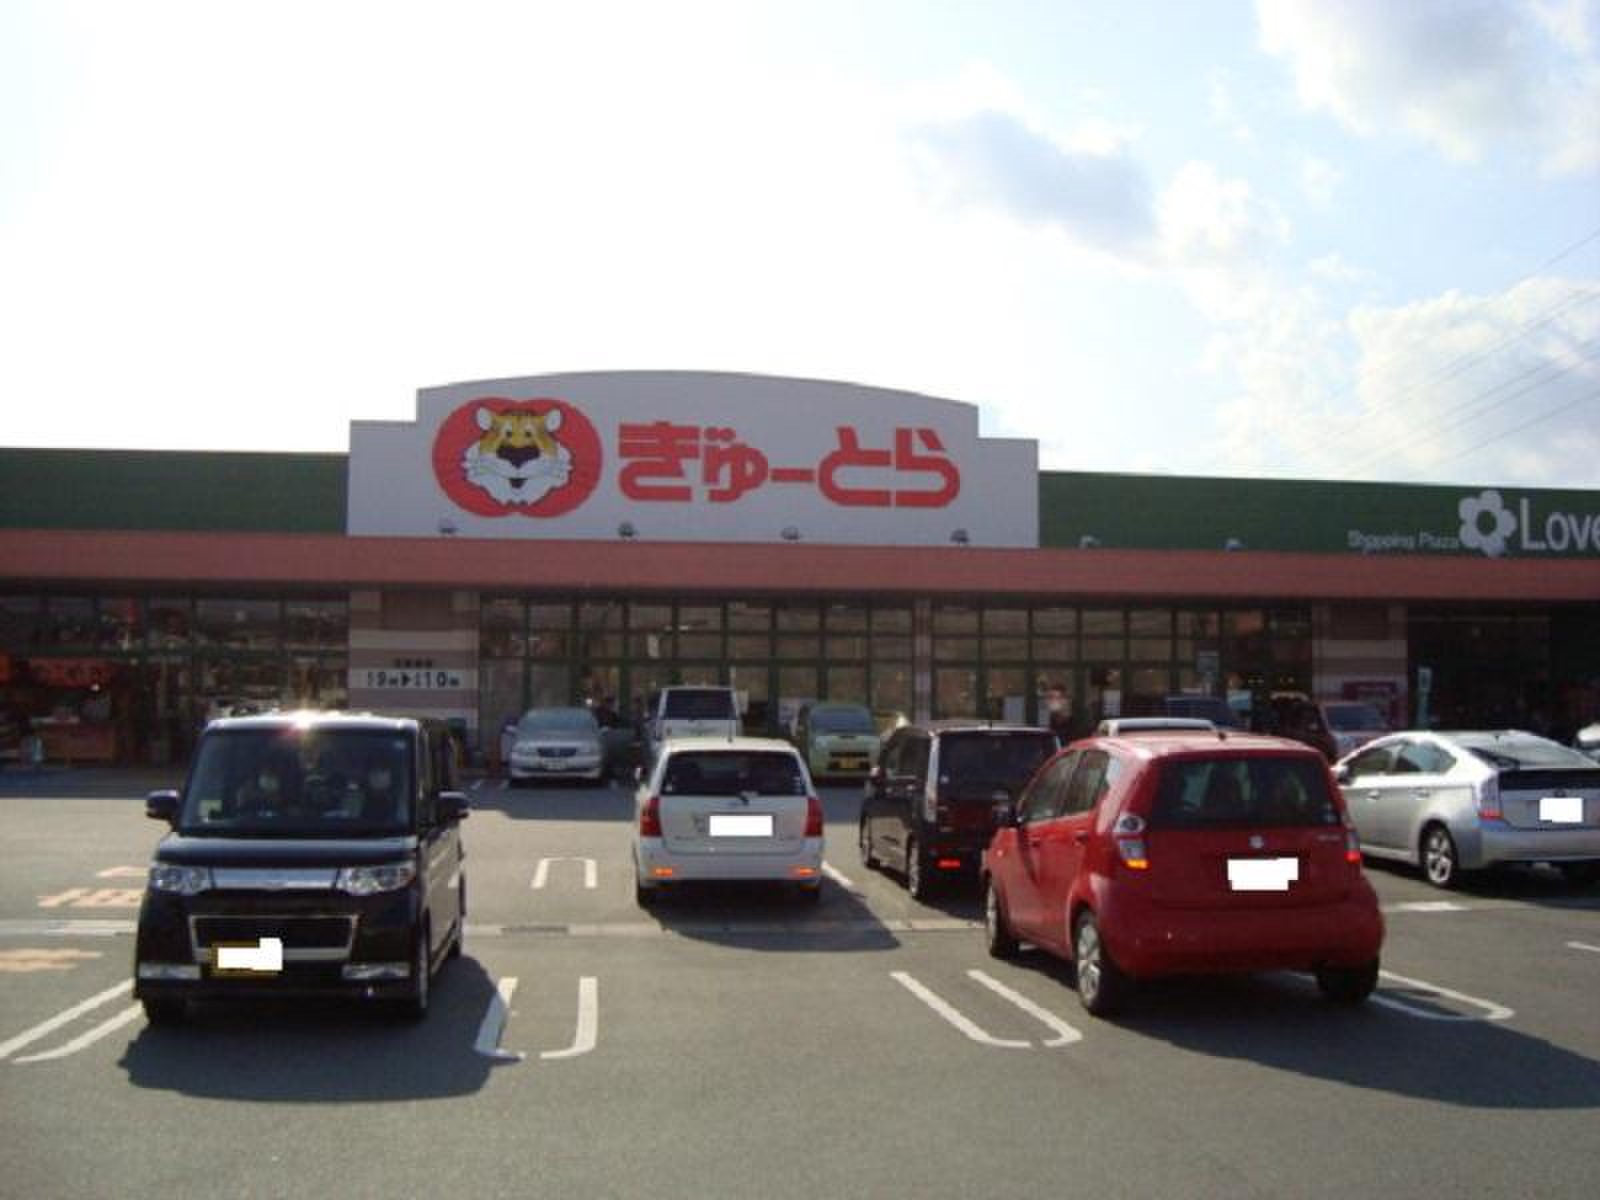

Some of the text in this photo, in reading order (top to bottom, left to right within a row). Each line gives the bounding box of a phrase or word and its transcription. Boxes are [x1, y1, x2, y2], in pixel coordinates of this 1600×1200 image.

[618, 421, 961, 508] ぎゅーとら
